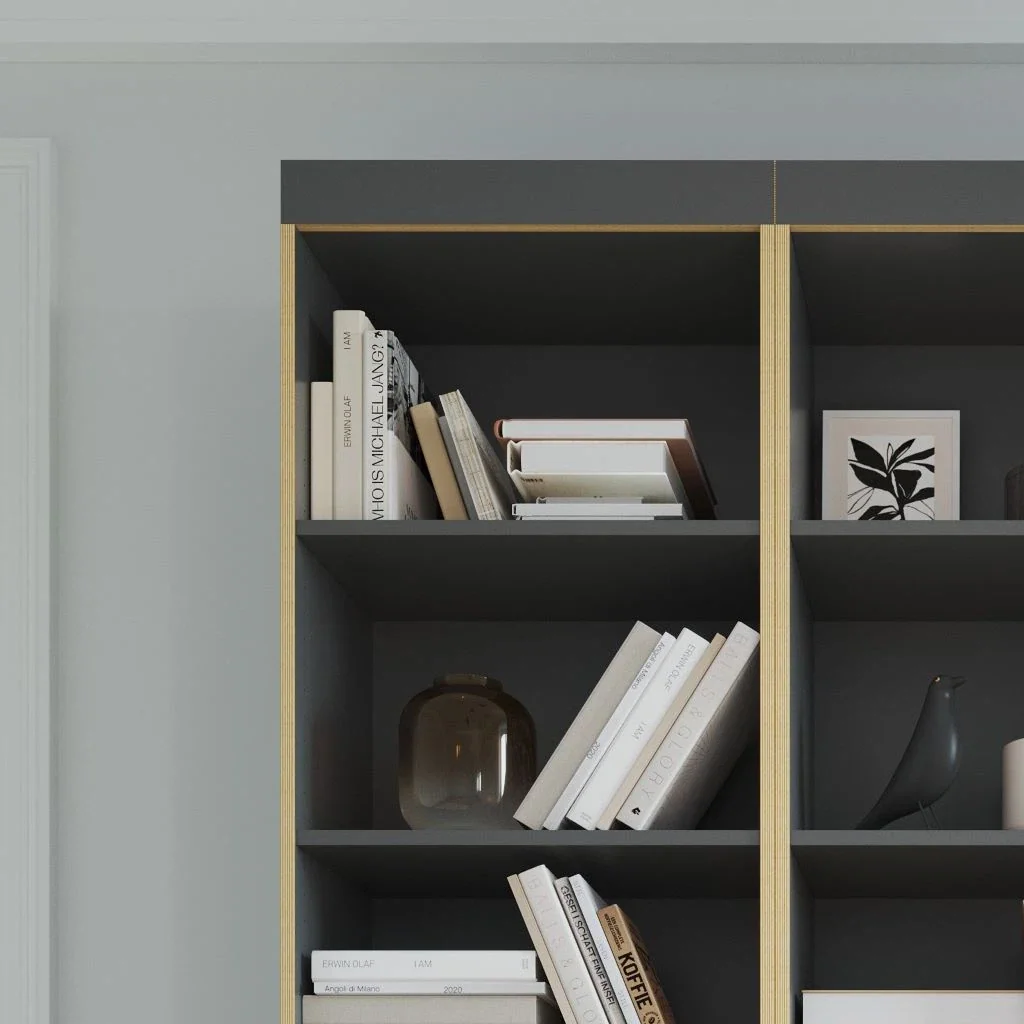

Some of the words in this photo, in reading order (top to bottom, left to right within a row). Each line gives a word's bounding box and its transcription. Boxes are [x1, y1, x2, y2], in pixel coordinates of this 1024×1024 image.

[371, 343, 385, 395] JANG?
[343, 395, 352, 417] OLAF
[343, 418, 352, 448] ERWIN
[371, 396, 385, 467] MICHAEL
[371, 469, 385, 484] IS
[321, 959, 350, 968] ERWIN
[351, 959, 375, 968] OLAF
[324, 985, 349, 994] Angoli
[350, 985, 356, 993] di
[357, 985, 381, 993] Milano
[443, 986, 463, 994] 2020
[617, 951, 652, 1010] KOFFIE
